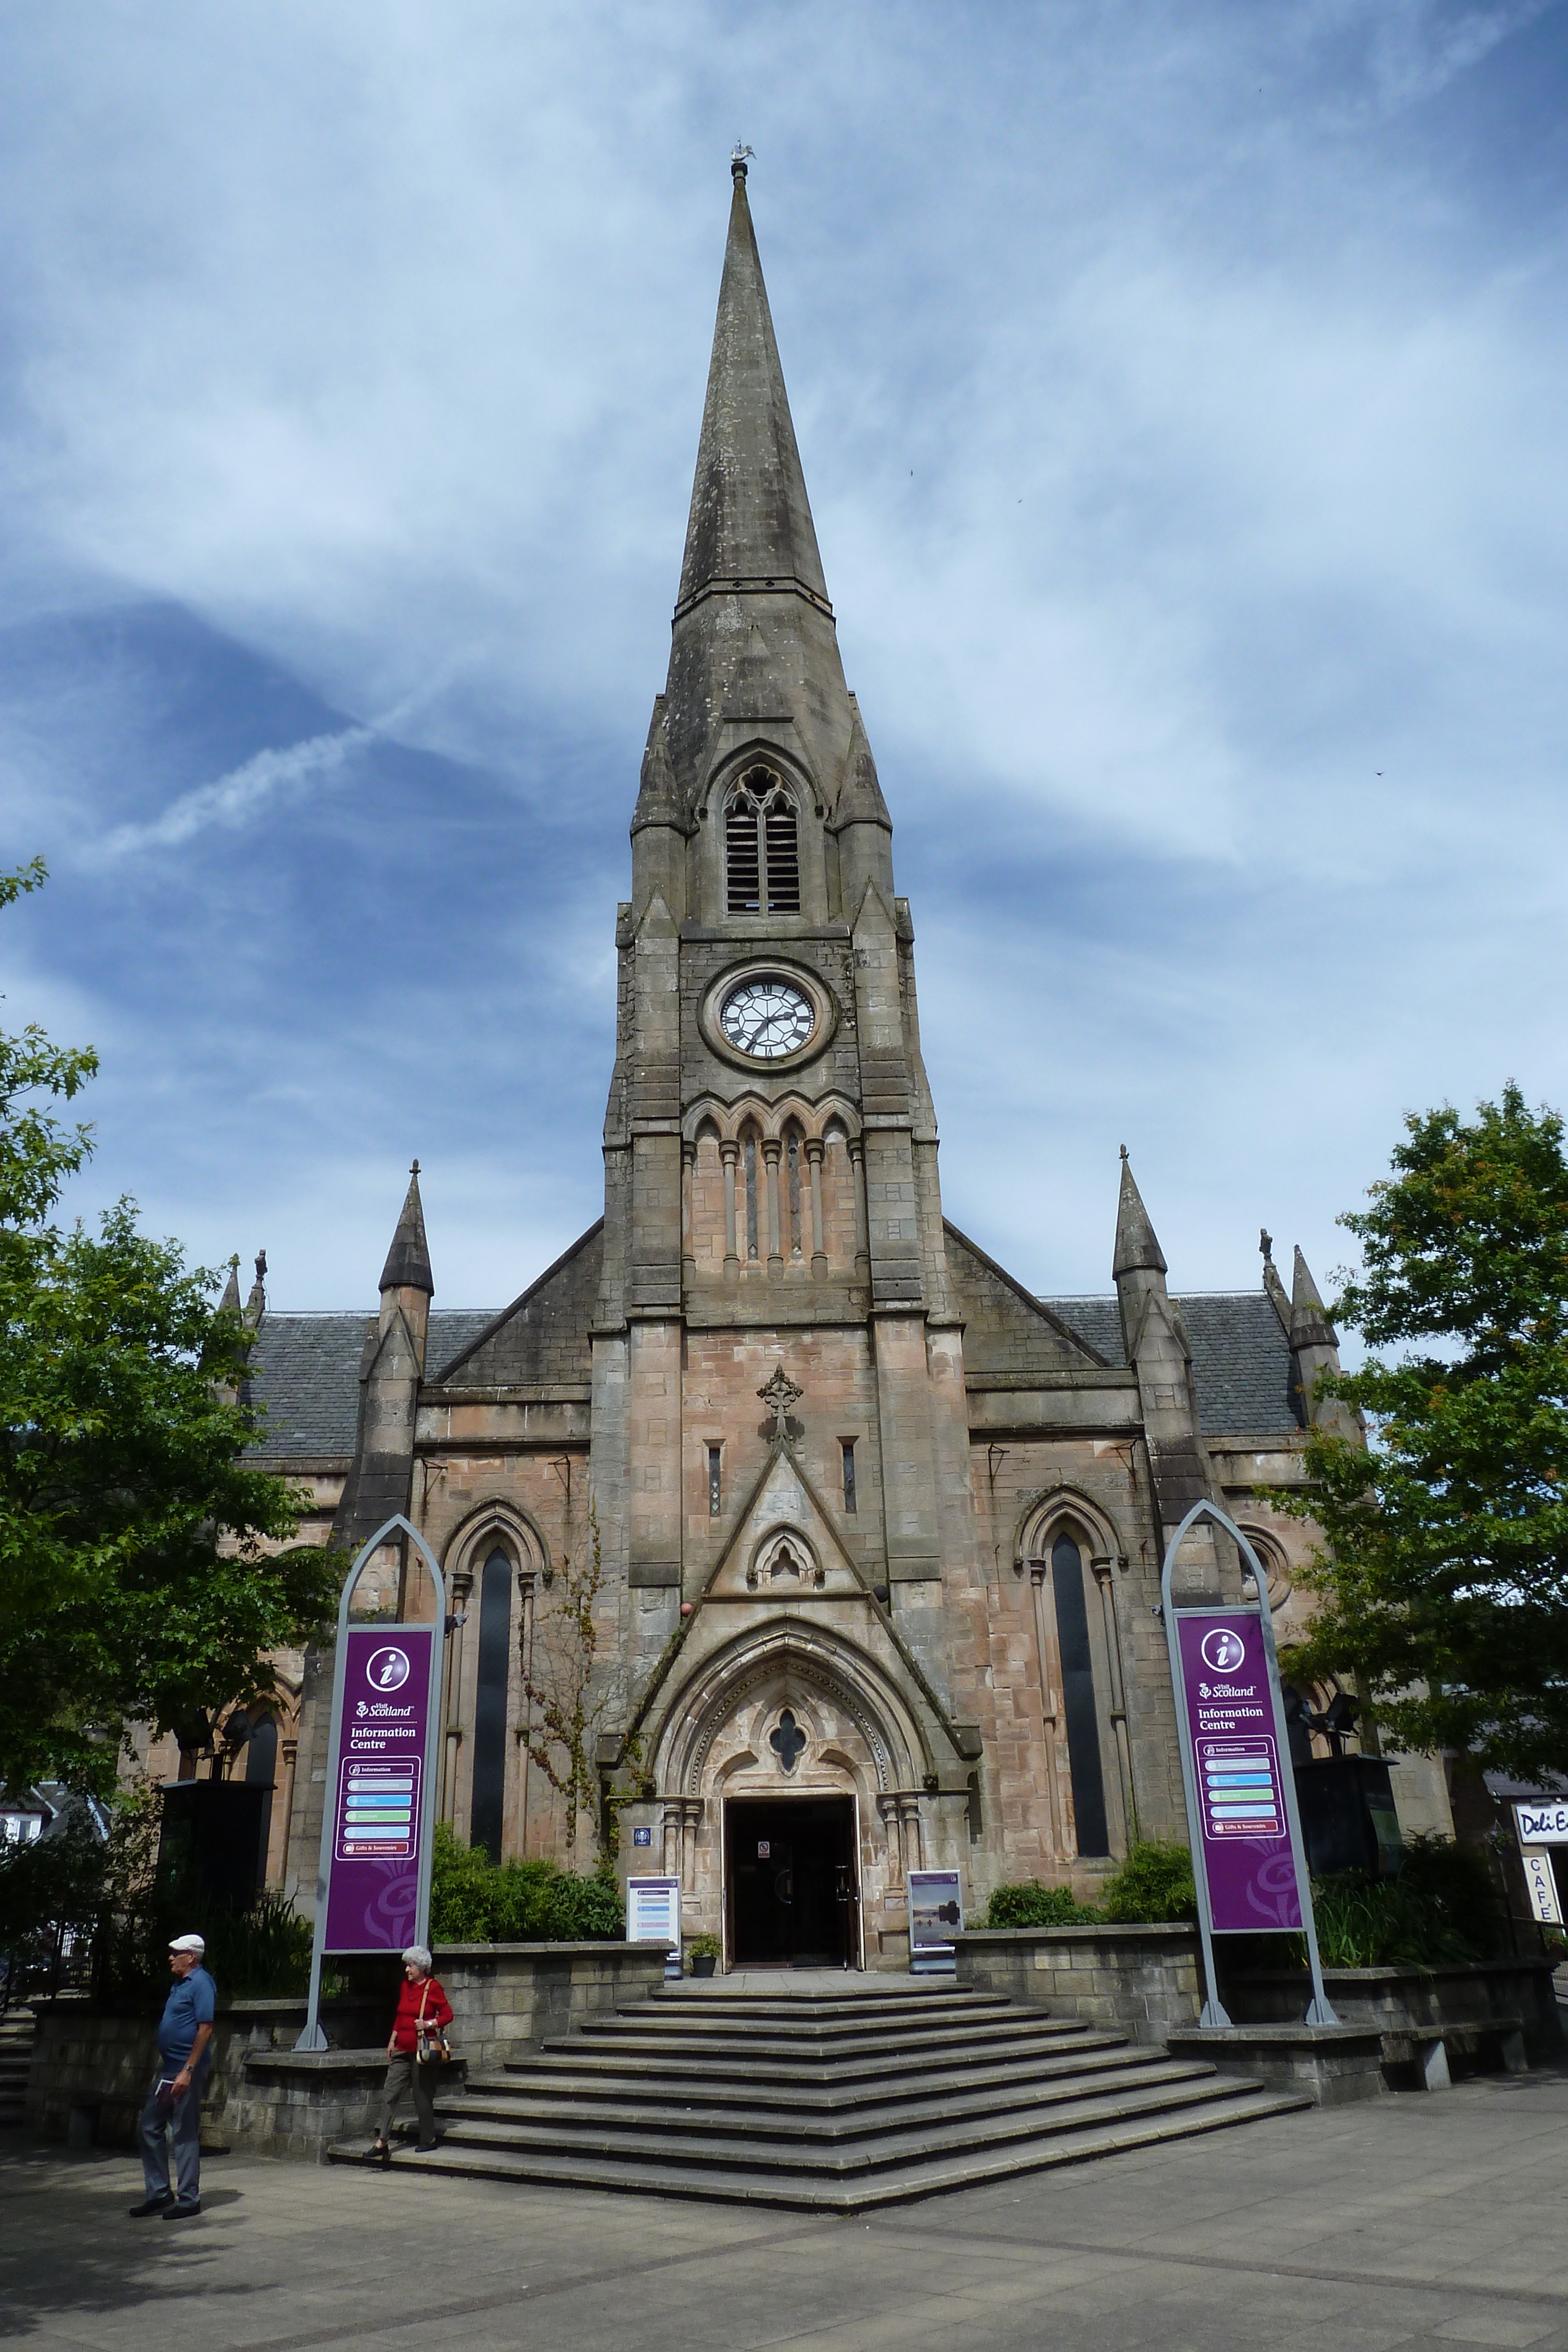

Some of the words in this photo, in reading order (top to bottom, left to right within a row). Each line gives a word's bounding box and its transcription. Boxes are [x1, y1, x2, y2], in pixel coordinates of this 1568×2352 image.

[1213, 1686, 1253, 1698] Scotland
[369, 1705, 410, 1716] Scotland
[1198, 1707, 1263, 1719] Information
[1199, 1720, 1236, 1730] Centre
[351, 1728, 416, 1738] Information
[350, 1739, 386, 1749] Centre
[1521, 1812, 1555, 1835] Deli
[1530, 1859, 1552, 1920] CAFÉ
